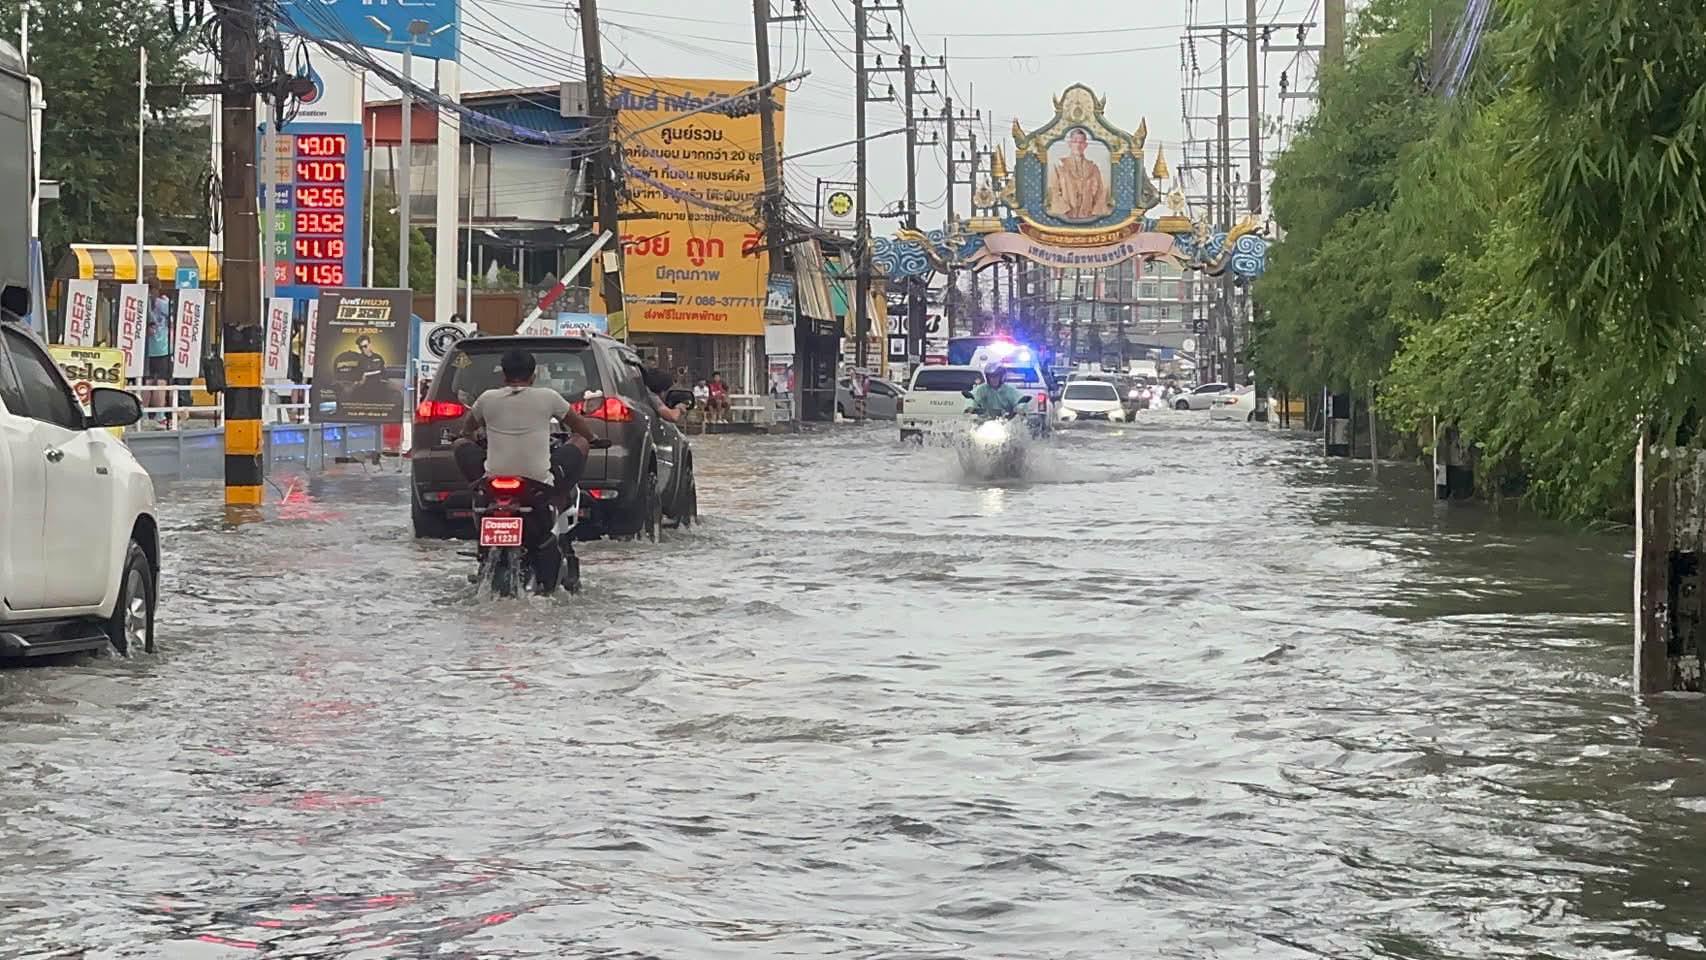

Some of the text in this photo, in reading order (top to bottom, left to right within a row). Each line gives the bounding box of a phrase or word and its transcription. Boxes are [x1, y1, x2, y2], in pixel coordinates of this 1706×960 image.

[661, 124, 723, 144] ศูนย์รวม
[297, 136, 345, 155] 49.07
[683, 148, 728, 161] มากกว่า
[732, 152, 746, 161] 20
[297, 162, 345, 181] 47.07
[296, 188, 344, 207] 42.56
[297, 213, 344, 232] 33.52
[296, 239, 344, 258] 41.19
[686, 237, 725, 266] ถูก
[188, 271, 197, 280] P
[295, 265, 343, 284] 41.56
[656, 266, 720, 284] มีคุณภาพ
[69, 292, 87, 344] UPER
[82, 295, 94, 338] POWER
[134, 299, 145, 340] POWER
[191, 304, 202, 343] POWER
[122, 295, 138, 367] SUPER
[178, 300, 195, 368] SUPER
[268, 308, 283, 370] SUPER
[59, 362, 121, 383] ระไดร์
[929, 399, 954, 407] ISUZU
